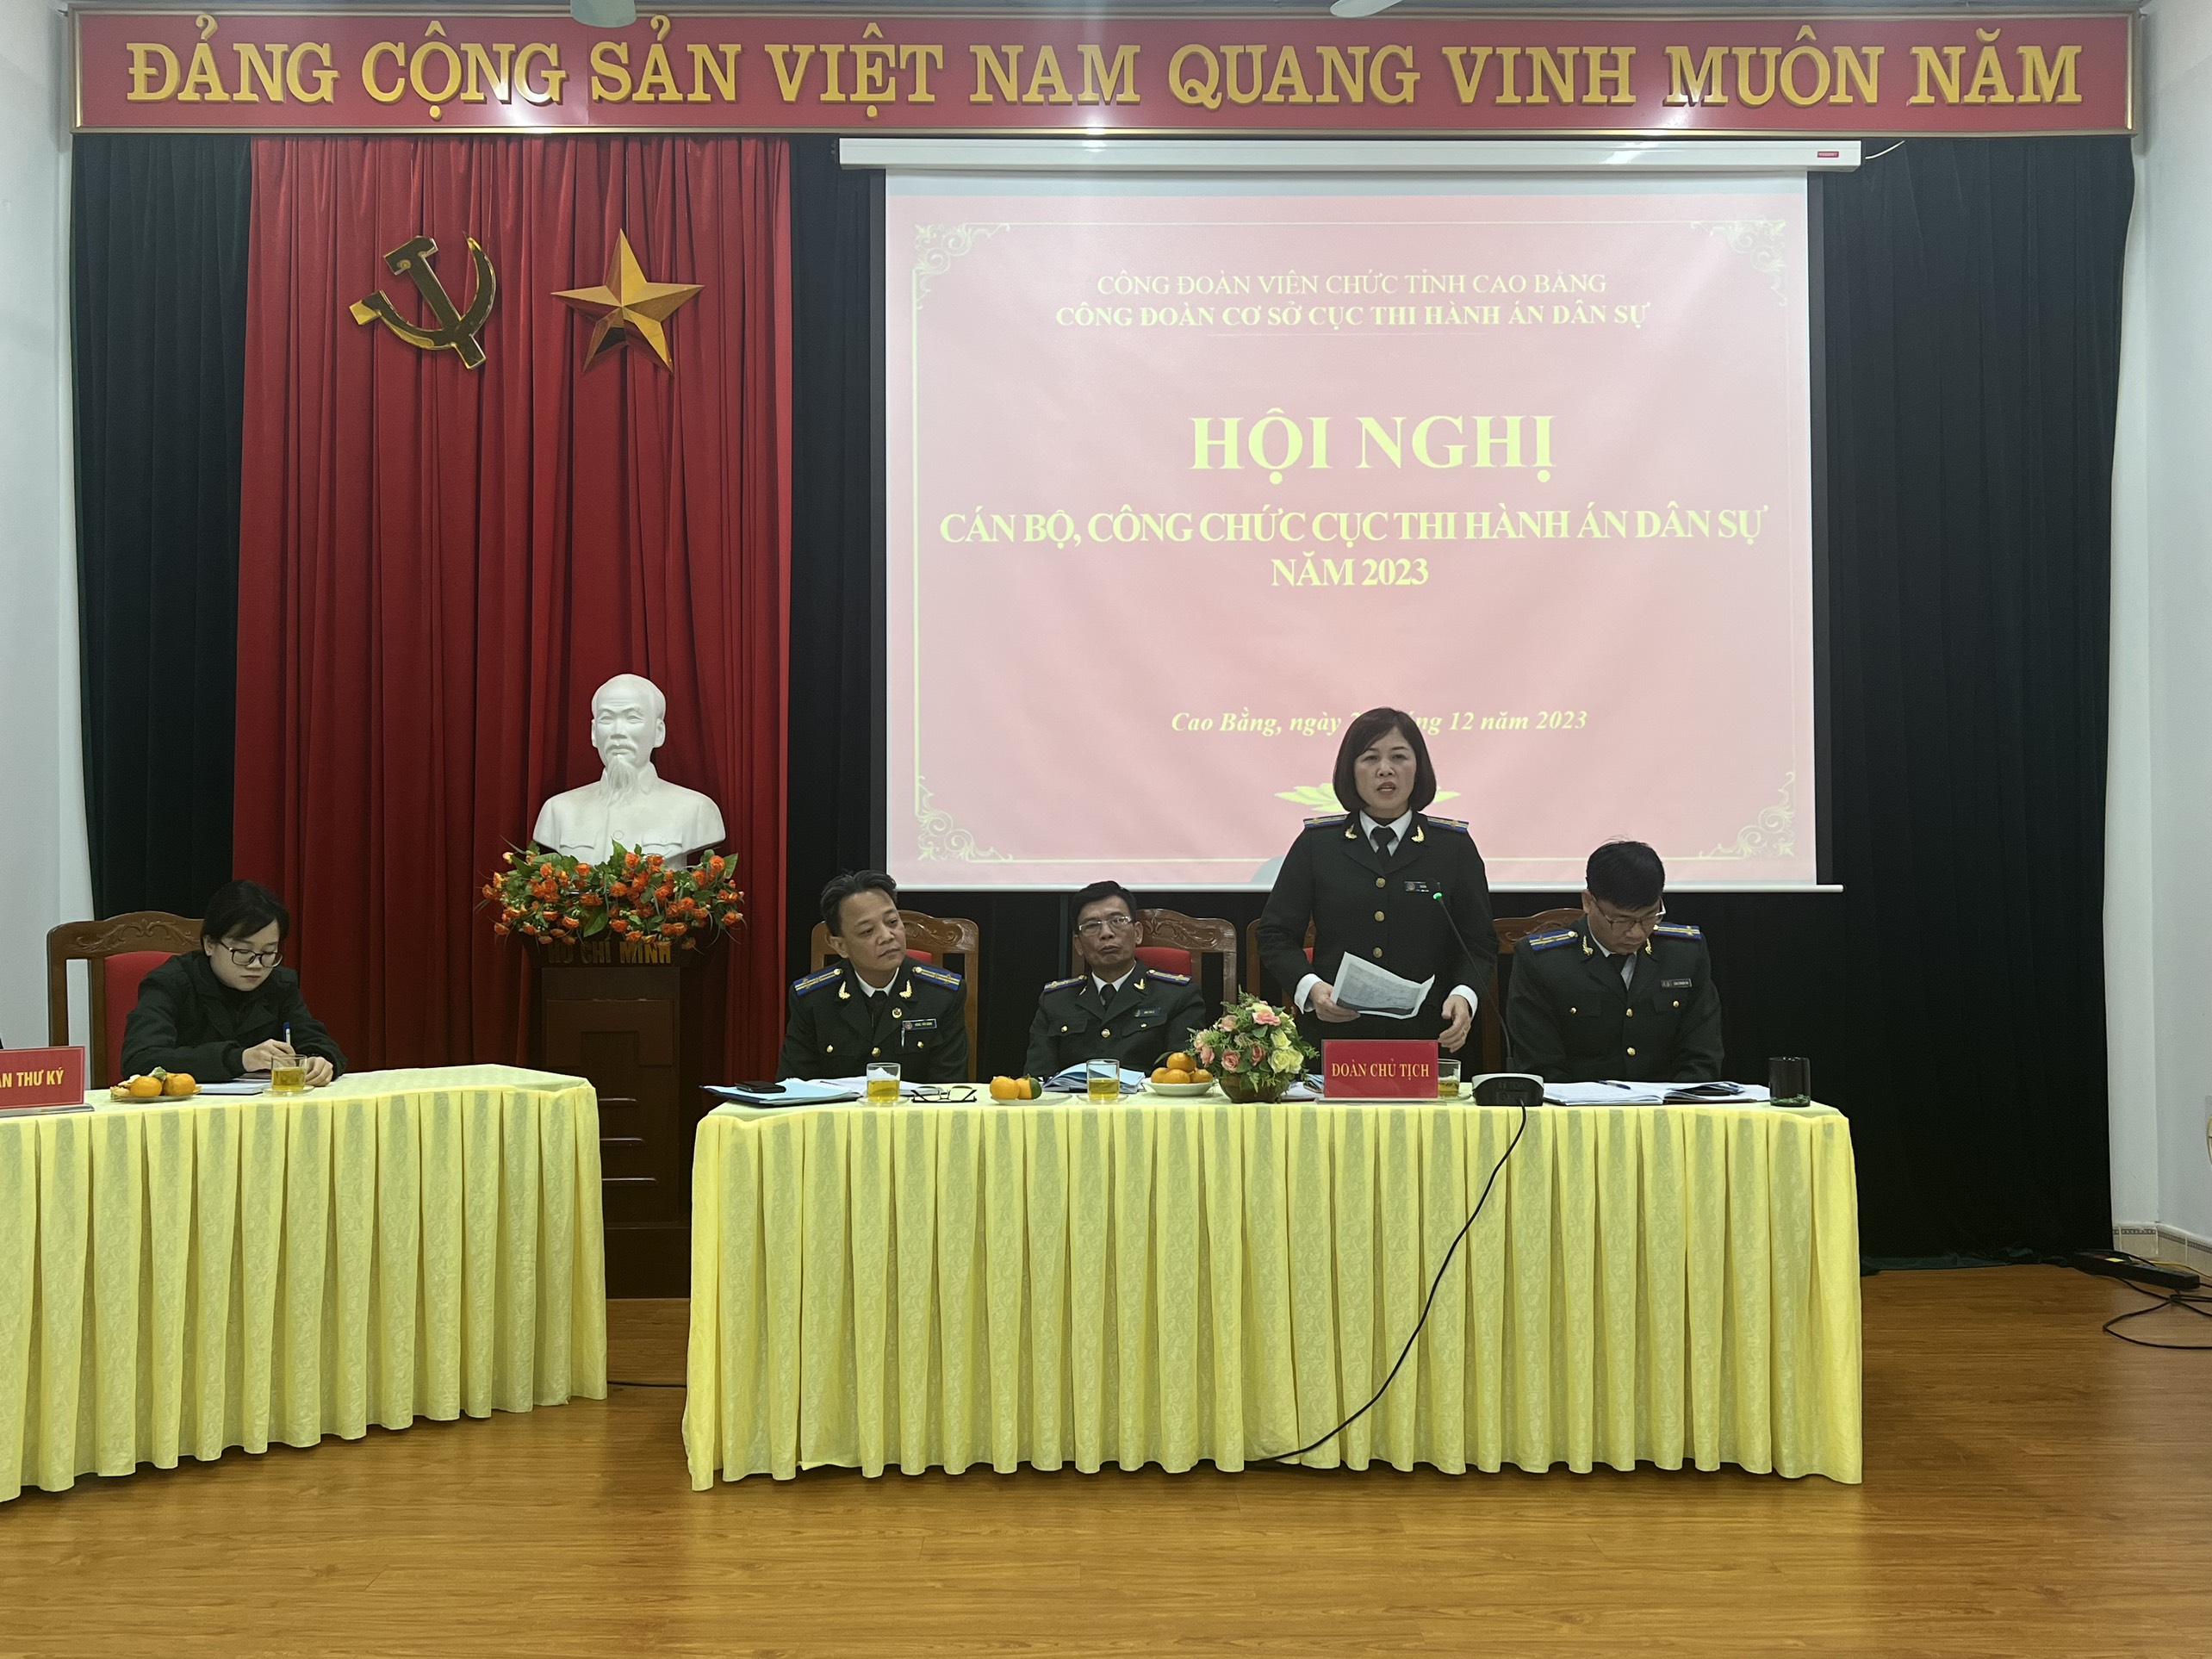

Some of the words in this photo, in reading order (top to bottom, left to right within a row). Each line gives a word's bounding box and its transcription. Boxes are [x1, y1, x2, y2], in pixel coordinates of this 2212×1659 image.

[126, 14, 339, 103] ĐẢNG
[362, 21, 566, 119] CỘNG
[591, 15, 743, 103] SẢN
[764, 23, 943, 118] VIỆT
[969, 44, 1141, 104] NAM
[1168, 44, 1420, 109] QUANG
[1442, 46, 1636, 106] VINH
[1664, 24, 1885, 107] MUÔN
[1906, 28, 2083, 106] NĂM
[1097, 270, 1170, 295] CÔNG
[1177, 270, 1250, 295] ĐOÀN
[1258, 269, 1319, 295] VIÊN
[1326, 269, 1398, 294] CHỨC
[1472, 274, 1526, 294] CAO
[1056, 301, 1132, 326] CÔNG
[1139, 301, 1215, 326] ĐOÀN
[1221, 306, 1262, 326] CƠ
[1267, 301, 1302, 326] SỞ
[1308, 306, 1363, 330] CỤC
[1370, 306, 1417, 325] THI
[1424, 301, 1501, 325] HÀNH
[1507, 301, 1544, 325] ÁN
[1552, 299, 1607, 324] DÂN
[1613, 301, 1651, 328] SỰ
[1190, 407, 1333, 485] HỘI
[1355, 414, 1557, 483] NGHỊ
[940, 505, 1016, 544] CÁN
[1022, 509, 1082, 550] BỘ,
[1087, 504, 1194, 543] CÔNG
[1199, 504, 1307, 542] CHỨC
[1311, 511, 1389, 549] CỤC
[1394, 512, 1459, 540] THI
[1464, 502, 1571, 539] HÀNH
[1576, 501, 1629, 538] ÁN
[1636, 500, 1712, 538] DÂN
[1718, 505, 1769, 545] SỰ
[1271, 551, 1356, 587] NĂM
[1362, 557, 1430, 586] 2023
[1171, 712, 1213, 731] Cao
[1219, 707, 1282, 736] Bằng,
[1289, 711, 1342, 736] ngày
[1449, 711, 1475, 730] 12
[1480, 711, 1529, 730] năm
[1535, 711, 1588, 730] 2023
[16, 1069, 45, 1088] THƯ
[46, 1066, 65, 1086] KÝ
[1331, 1059, 1367, 1078] ĐOÀN
[1370, 1058, 1396, 1078] CHỦ
[1399, 1063, 1430, 1081] TỊCH
